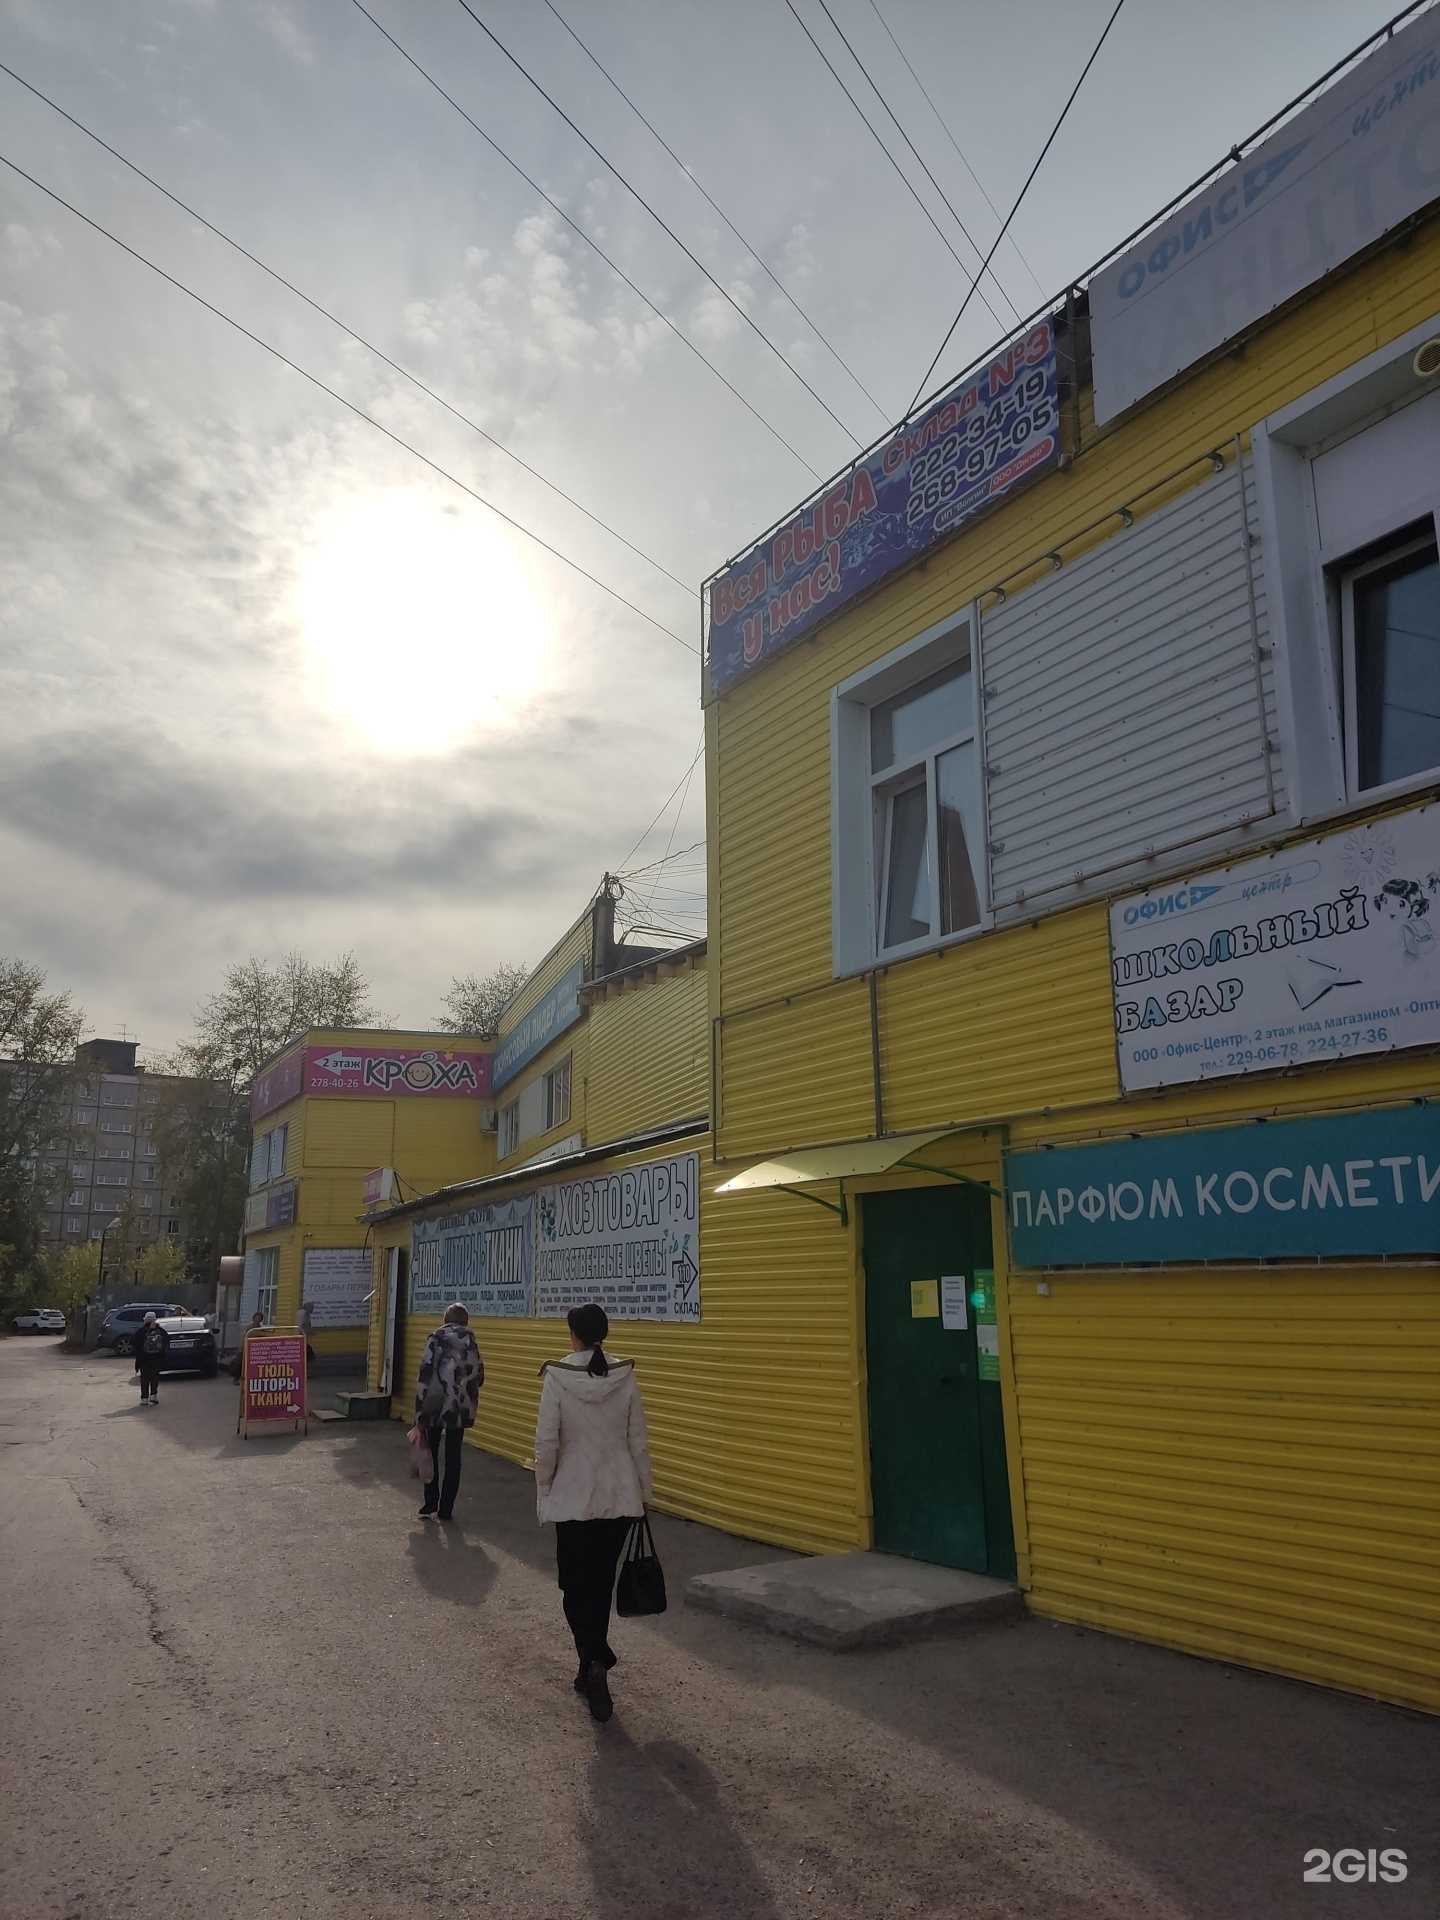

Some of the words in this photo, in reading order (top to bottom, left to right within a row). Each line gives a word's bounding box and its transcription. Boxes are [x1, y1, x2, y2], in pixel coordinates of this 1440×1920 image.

[1118, 187, 1239, 298] ОФИС
[909, 370, 1046, 487] 222-34-19
[906, 402, 1053, 525] 268-97-05
[712, 559, 767, 626] Вся
[770, 466, 878, 581] РЫБА
[768, 541, 840, 634] нас!
[1123, 891, 1188, 925] ОФИС
[1241, 873, 1292, 900] центр
[1114, 886, 1369, 987] ШКОЛЬНЫЙ
[1115, 979, 1243, 1034] БАЗАР
[1133, 1048, 1158, 1063] ООО
[1254, 1029, 1262, 1041] 2
[1265, 1025, 1296, 1039] этаж
[1298, 1022, 1322, 1034] над
[1324, 1006, 1400, 1028] магазином
[1307, 1028, 1388, 1052] 224-27-36
[311, 1078, 359, 1088] 278-40-26
[323, 1058, 329, 1067] 2
[332, 1059, 361, 1069] этаж
[364, 1051, 477, 1091] КРОХА
[559, 1159, 695, 1237] ХОЗТОВАРЫ
[1012, 1178, 1184, 1228] ПАРФЮМ
[1195, 1154, 1440, 1216] КОСМЕТИ
[484, 1225, 523, 1285] ТКАНИ
[540, 1244, 623, 1281] ИСКУССТВЕННЫЕ
[626, 1239, 666, 1284] ЦВЕТЫ
[674, 1302, 699, 1316] СКЛАД
[249, 1377, 299, 1392] ШТОРЫ
[249, 1392, 291, 1405] ТКАНИ
[257, 1364, 294, 1377] ТЮЛЬ
